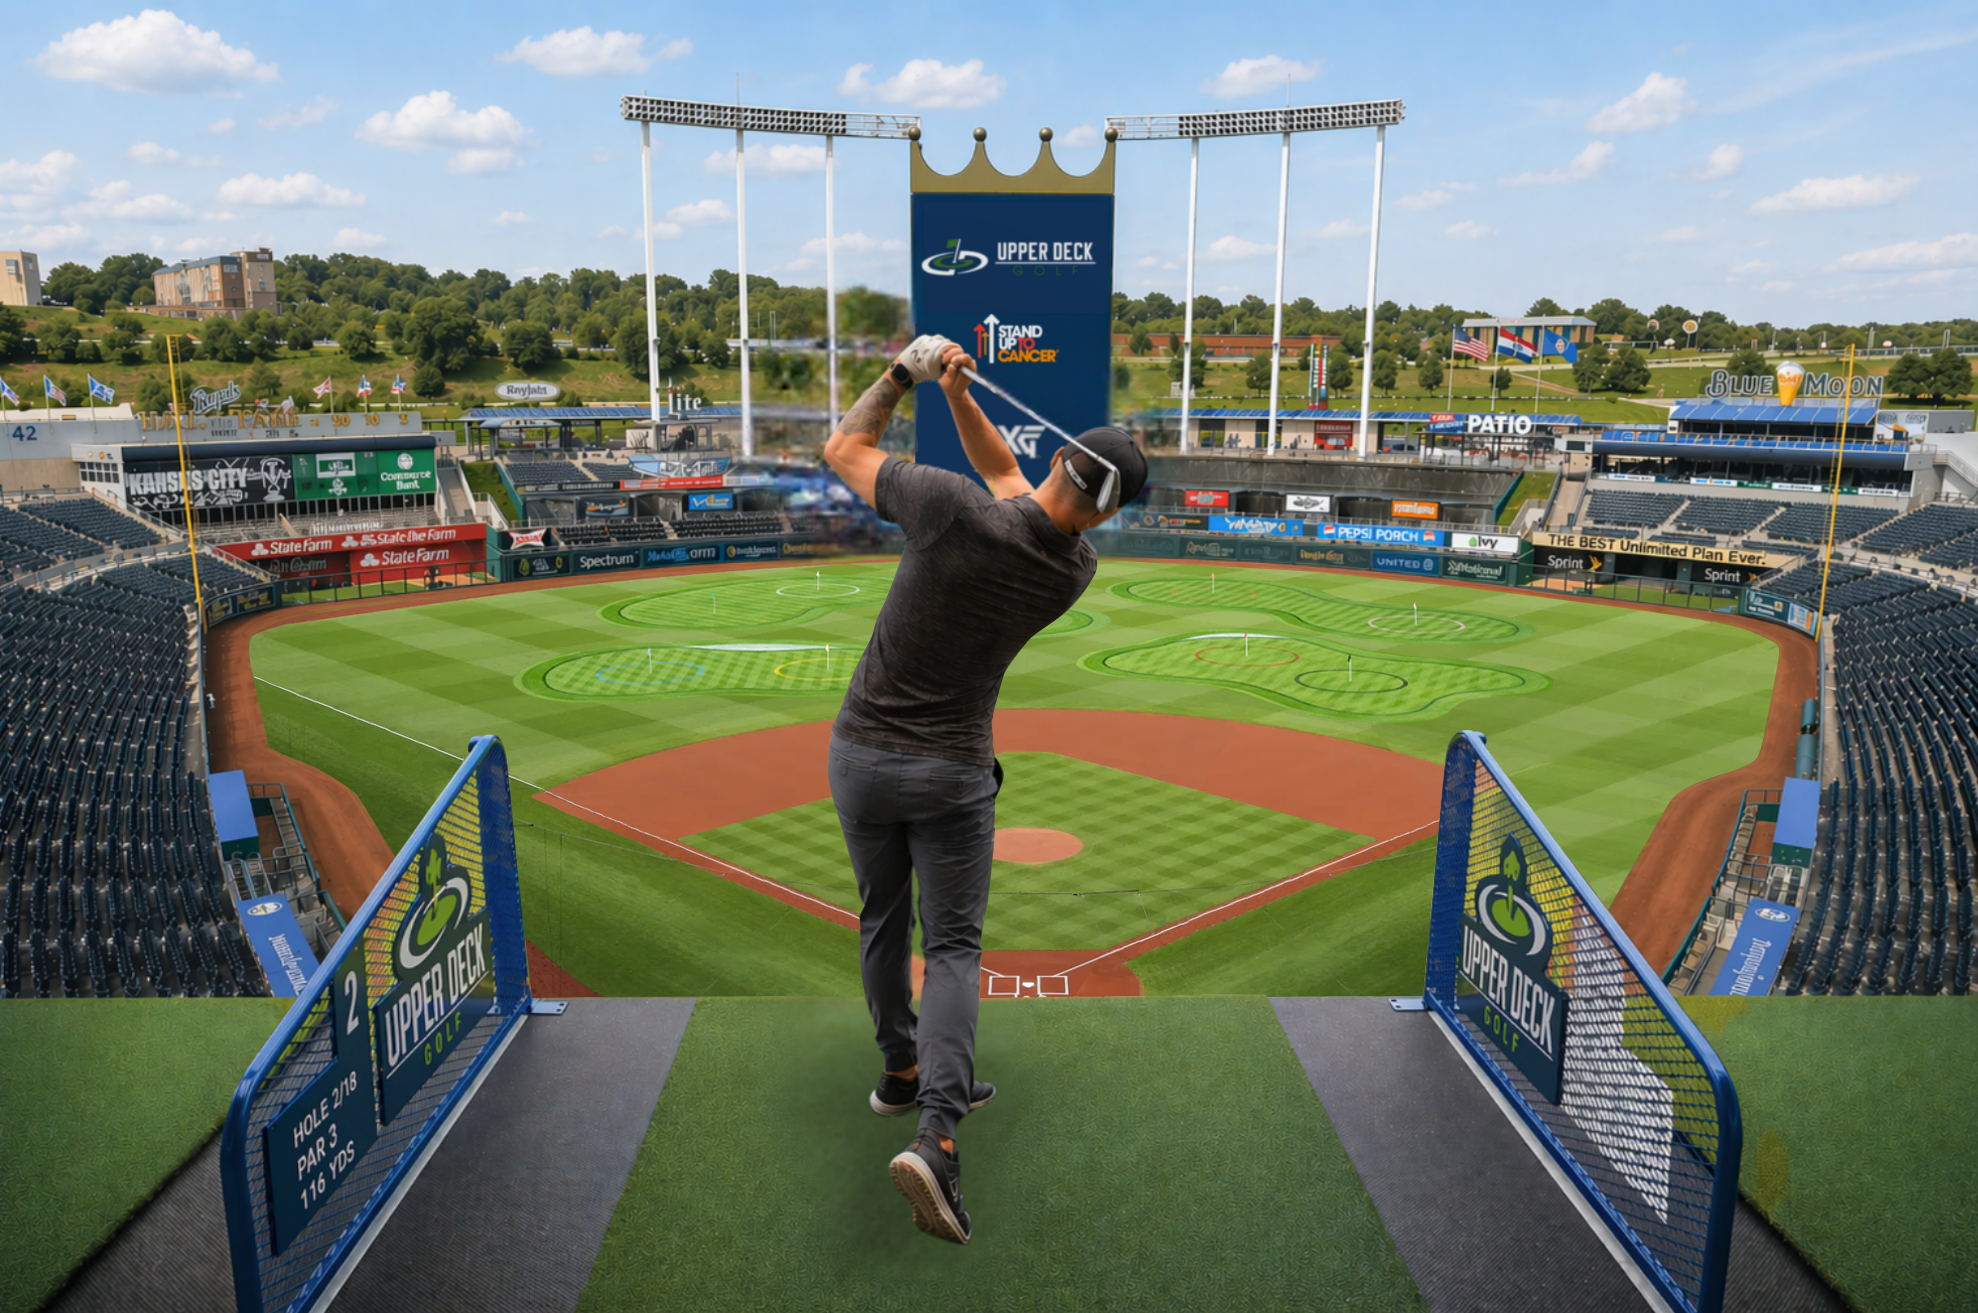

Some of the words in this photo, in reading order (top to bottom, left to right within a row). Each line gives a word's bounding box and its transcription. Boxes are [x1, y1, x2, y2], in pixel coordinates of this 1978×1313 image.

[997, 242, 1048, 261] UPPER
[1053, 242, 1094, 261] DECK
[1012, 265, 1079, 276] GOLF
[998, 325, 1043, 338] STAND
[998, 337, 1017, 350] UP
[1016, 337, 1036, 350] TO
[997, 349, 1056, 362] CANCER
[1705, 368, 1774, 398] BLUE
[1804, 371, 1884, 397] MOON
[12, 425, 37, 441] 42
[1467, 414, 1532, 435] PATIO
[207, 467, 248, 491] CITY
[1338, 526, 1373, 540] PEPSI
[1375, 528, 1419, 543] PORCH
[1548, 534, 1575, 547] THE
[1579, 536, 1616, 550] BEST
[1692, 546, 1724, 561] Plan
[579, 554, 634, 570] Spectrum
[1376, 557, 1421, 569] UNITED
[1547, 555, 1584, 569] Sprint
[1704, 568, 1741, 583] Sprint
[385, 962, 445, 1067] UPPER
[447, 922, 486, 1006] DECK
[1462, 925, 1509, 1011] UPPER
[1510, 966, 1555, 1055] DECK
[344, 970, 360, 1036] 2
[424, 1011, 461, 1066] GOLF
[1484, 1005, 1520, 1053] GOLF
[293, 1097, 330, 1149] HOLE
[331, 1070, 358, 1110] 2/18
[297, 1136, 326, 1181] PAR
[328, 1122, 339, 1149] 3
[300, 1171, 327, 1210] 116
[329, 1139, 356, 1180] YDS
